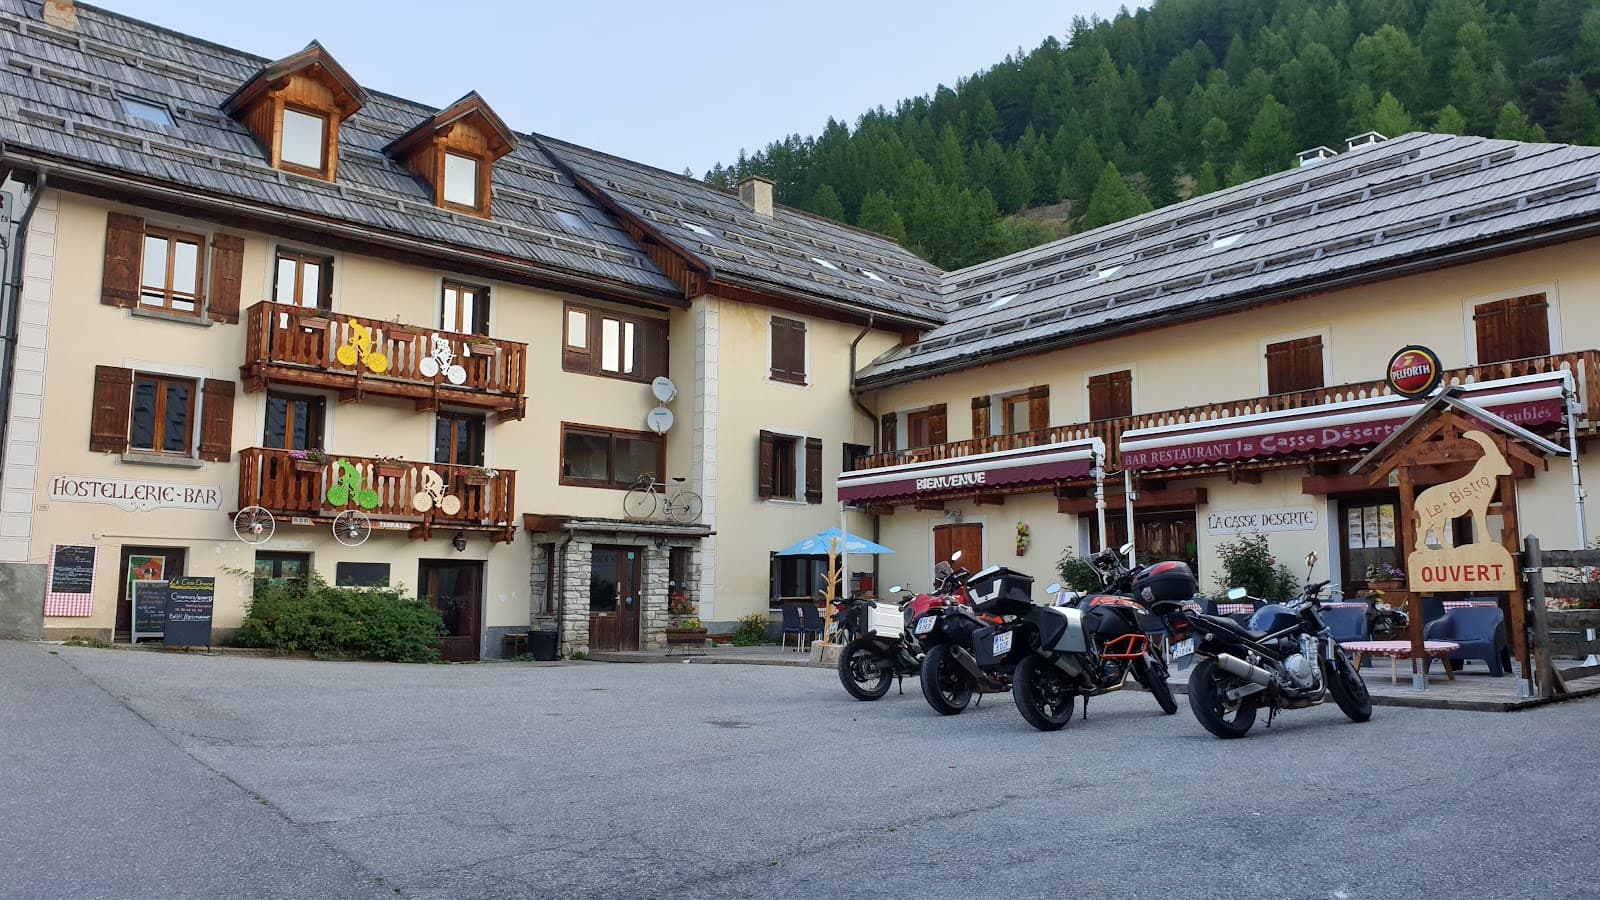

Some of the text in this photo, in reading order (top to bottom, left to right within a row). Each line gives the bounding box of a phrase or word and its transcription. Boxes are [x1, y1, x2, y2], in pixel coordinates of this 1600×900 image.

[1392, 364, 1430, 381] PELFORTH
[1124, 453, 1148, 466] BAR
[1151, 443, 1232, 463] RESTAURANT
[1236, 440, 1253, 453] la
[1260, 434, 1316, 452] Casse
[916, 471, 986, 490] BIENVENUE
[1207, 511, 1313, 529] LA CASSE DESERTE
[1425, 504, 1443, 518] Le
[1421, 564, 1503, 583] OUVERT
